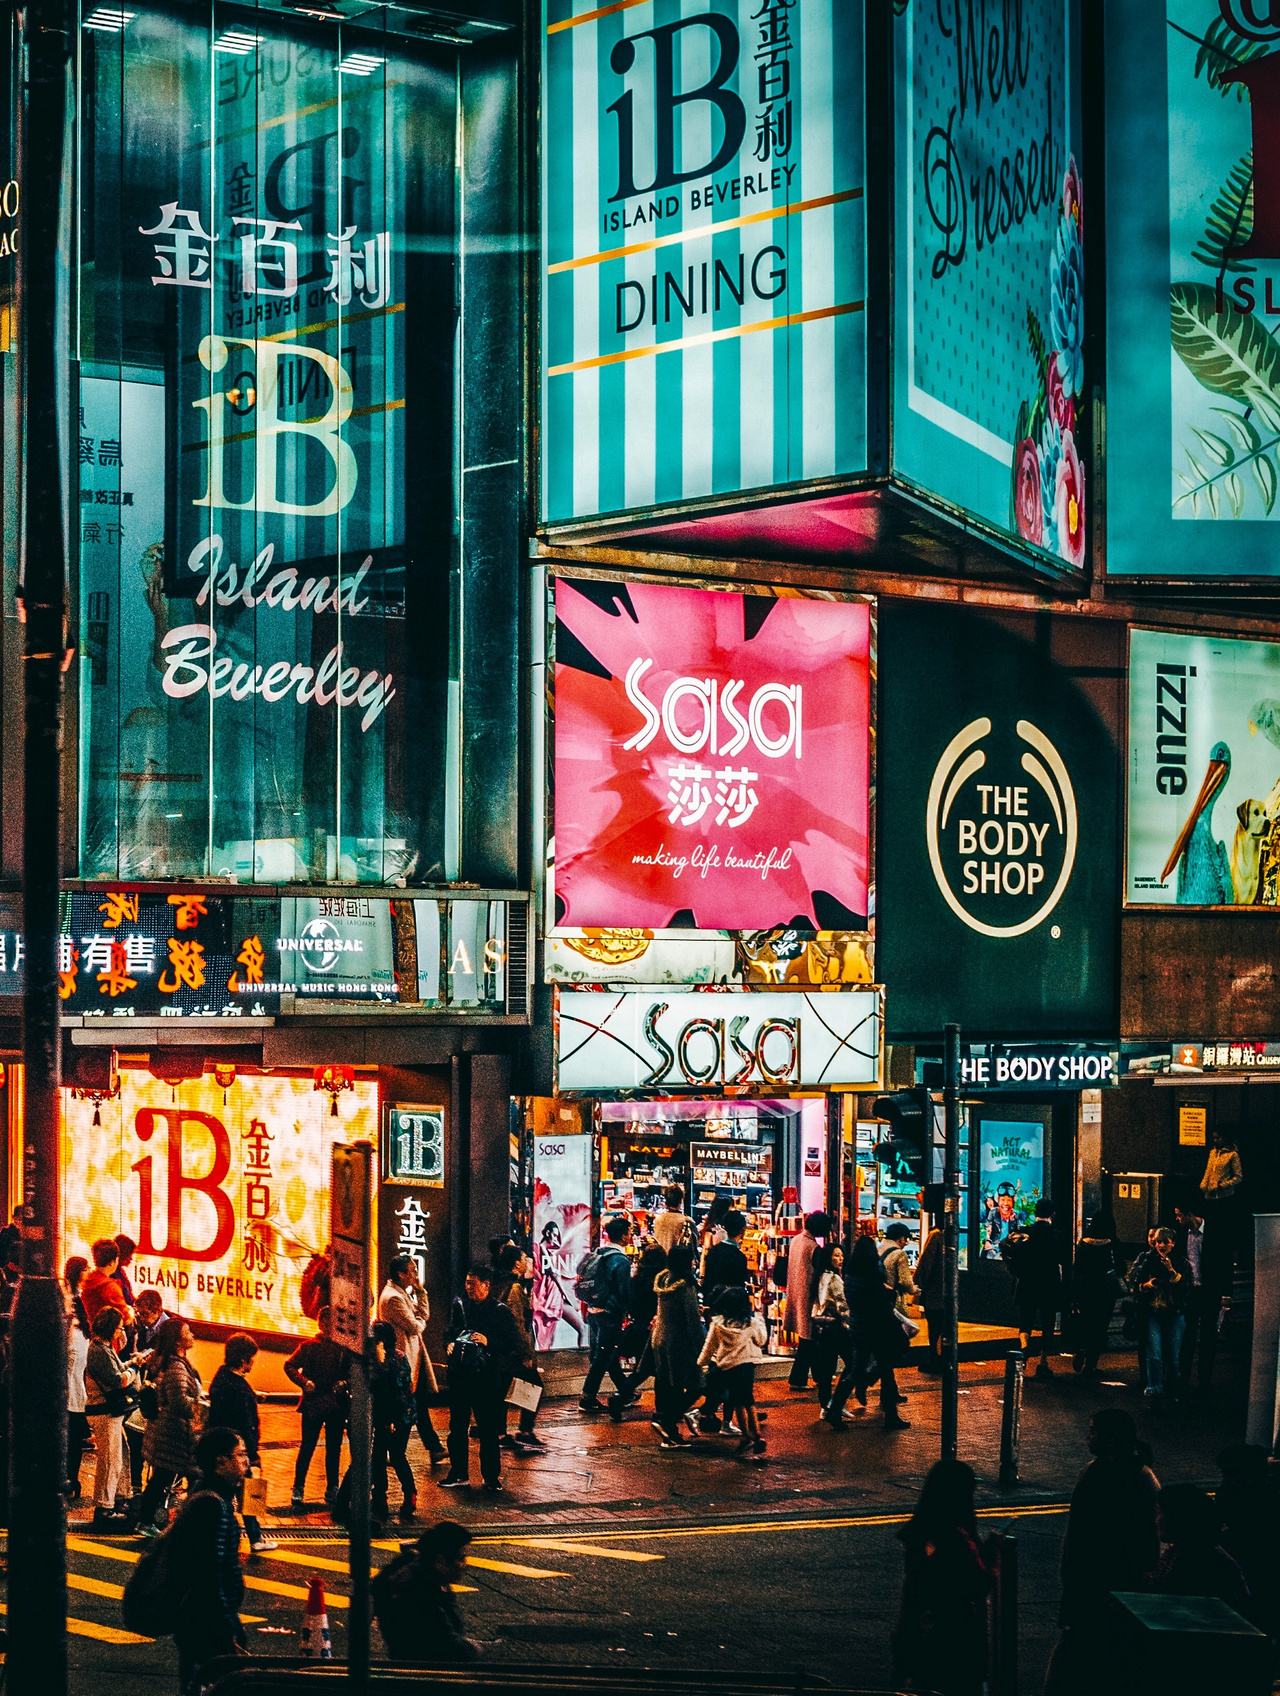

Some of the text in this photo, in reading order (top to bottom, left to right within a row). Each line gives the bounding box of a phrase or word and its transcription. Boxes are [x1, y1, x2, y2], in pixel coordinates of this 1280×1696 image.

[936, 0, 1030, 119] Well
[750, 0, 796, 162] 金百利
[924, 73, 1059, 279] Dressed
[604, 164, 796, 233] ISLAND BEVERLEY
[138, 201, 390, 308] 金百利
[616, 245, 787, 333] DINING
[192, 334, 359, 517] iB
[188, 534, 374, 616] Island
[161, 623, 396, 733] Beverley
[1155, 662, 1197, 796] izzue
[667, 763, 759, 828] 莎莎
[977, 784, 1028, 816] THE
[958, 819, 1050, 857] BODY
[632, 843, 793, 881] making life beautiful
[963, 860, 1045, 896] SHOP
[276, 938, 363, 951] UNIVERSAL
[447, 939, 474, 974] A
[238, 982, 399, 993] UNIVERSAL MUSIC HONG KONG
[996, 1056, 1056, 1082] BODY
[1202, 1046, 1256, 1066] 銅鑼灣站
[696, 1149, 767, 1162] MAYBELLINE
[990, 1147, 1033, 1160] NATURAL
[1002, 1136, 1022, 1148] ACT
[241, 1117, 277, 1274] 金百利
[133, 1264, 275, 1302] ISLAND BEVERLEY
